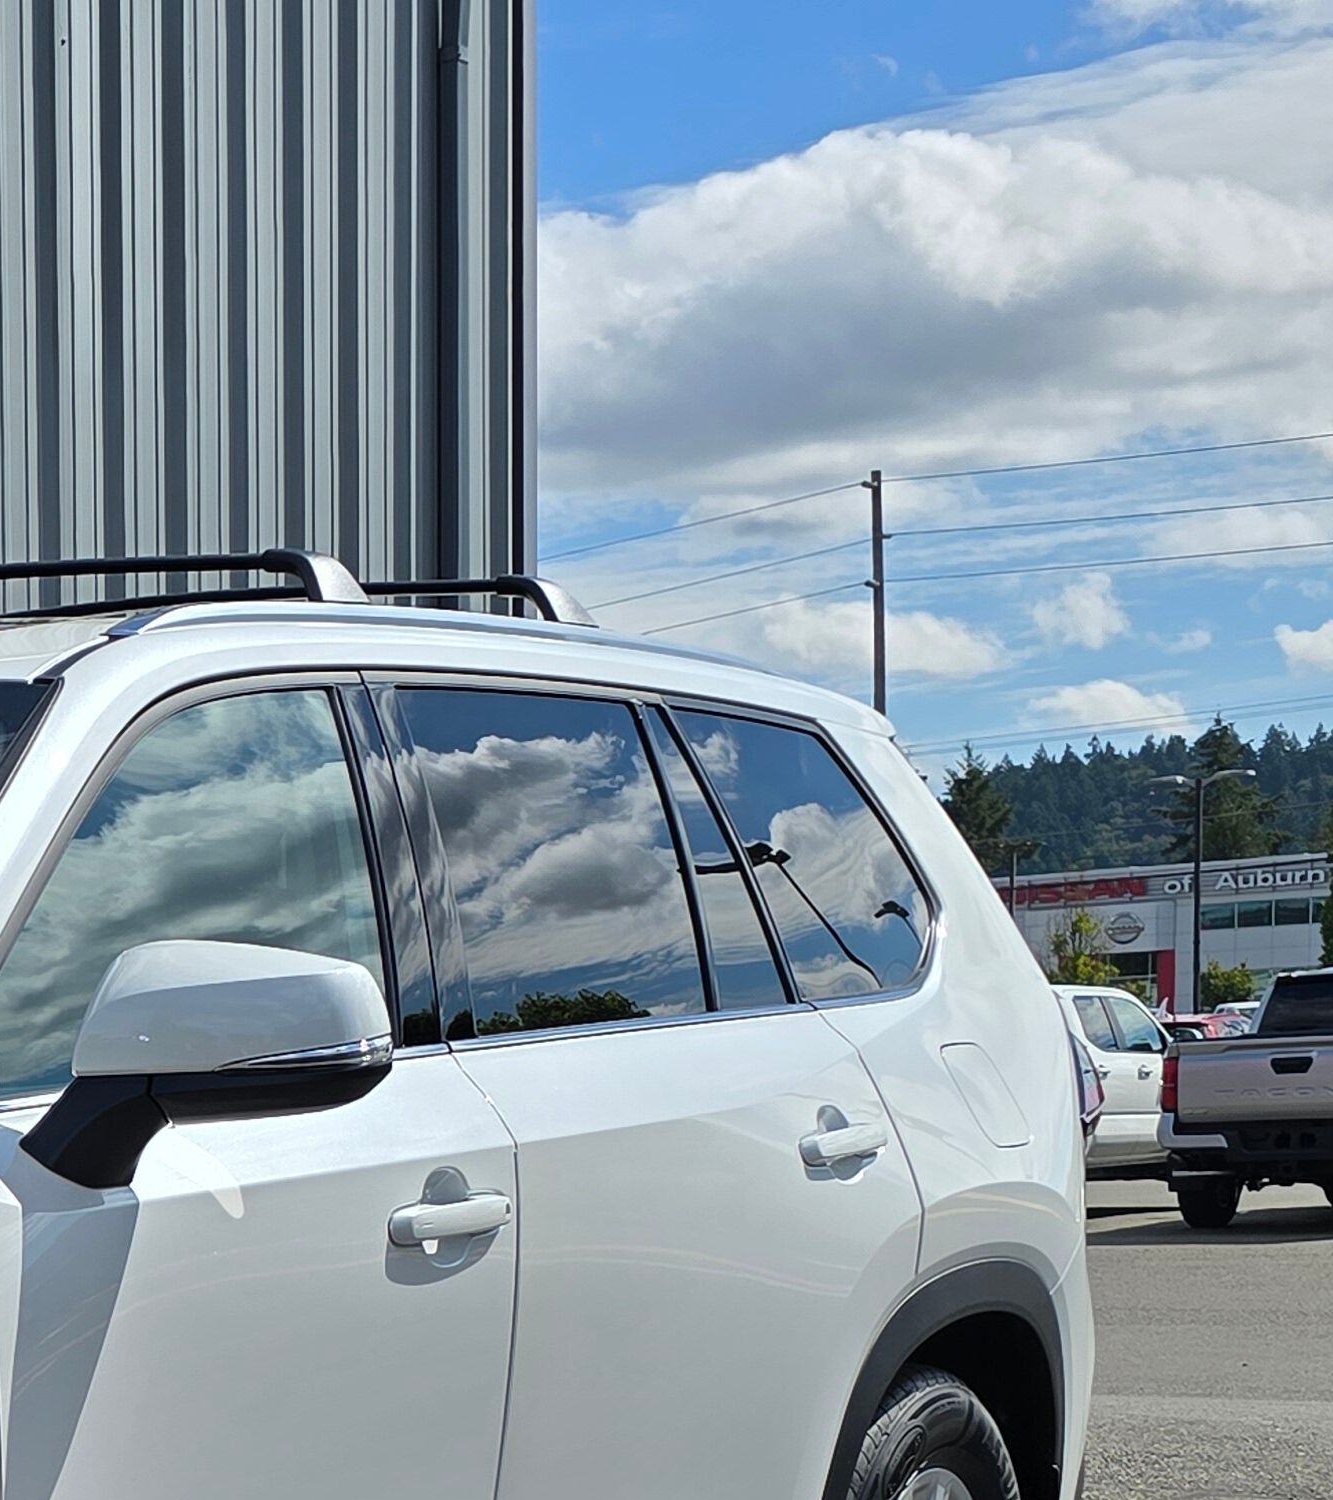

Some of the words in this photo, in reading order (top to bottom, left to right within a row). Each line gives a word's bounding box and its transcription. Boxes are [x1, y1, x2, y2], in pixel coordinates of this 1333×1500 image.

[1163, 877, 1193, 895] of
[1215, 867, 1326, 891] Auburn
[1213, 1086, 1333, 1097] TACO
